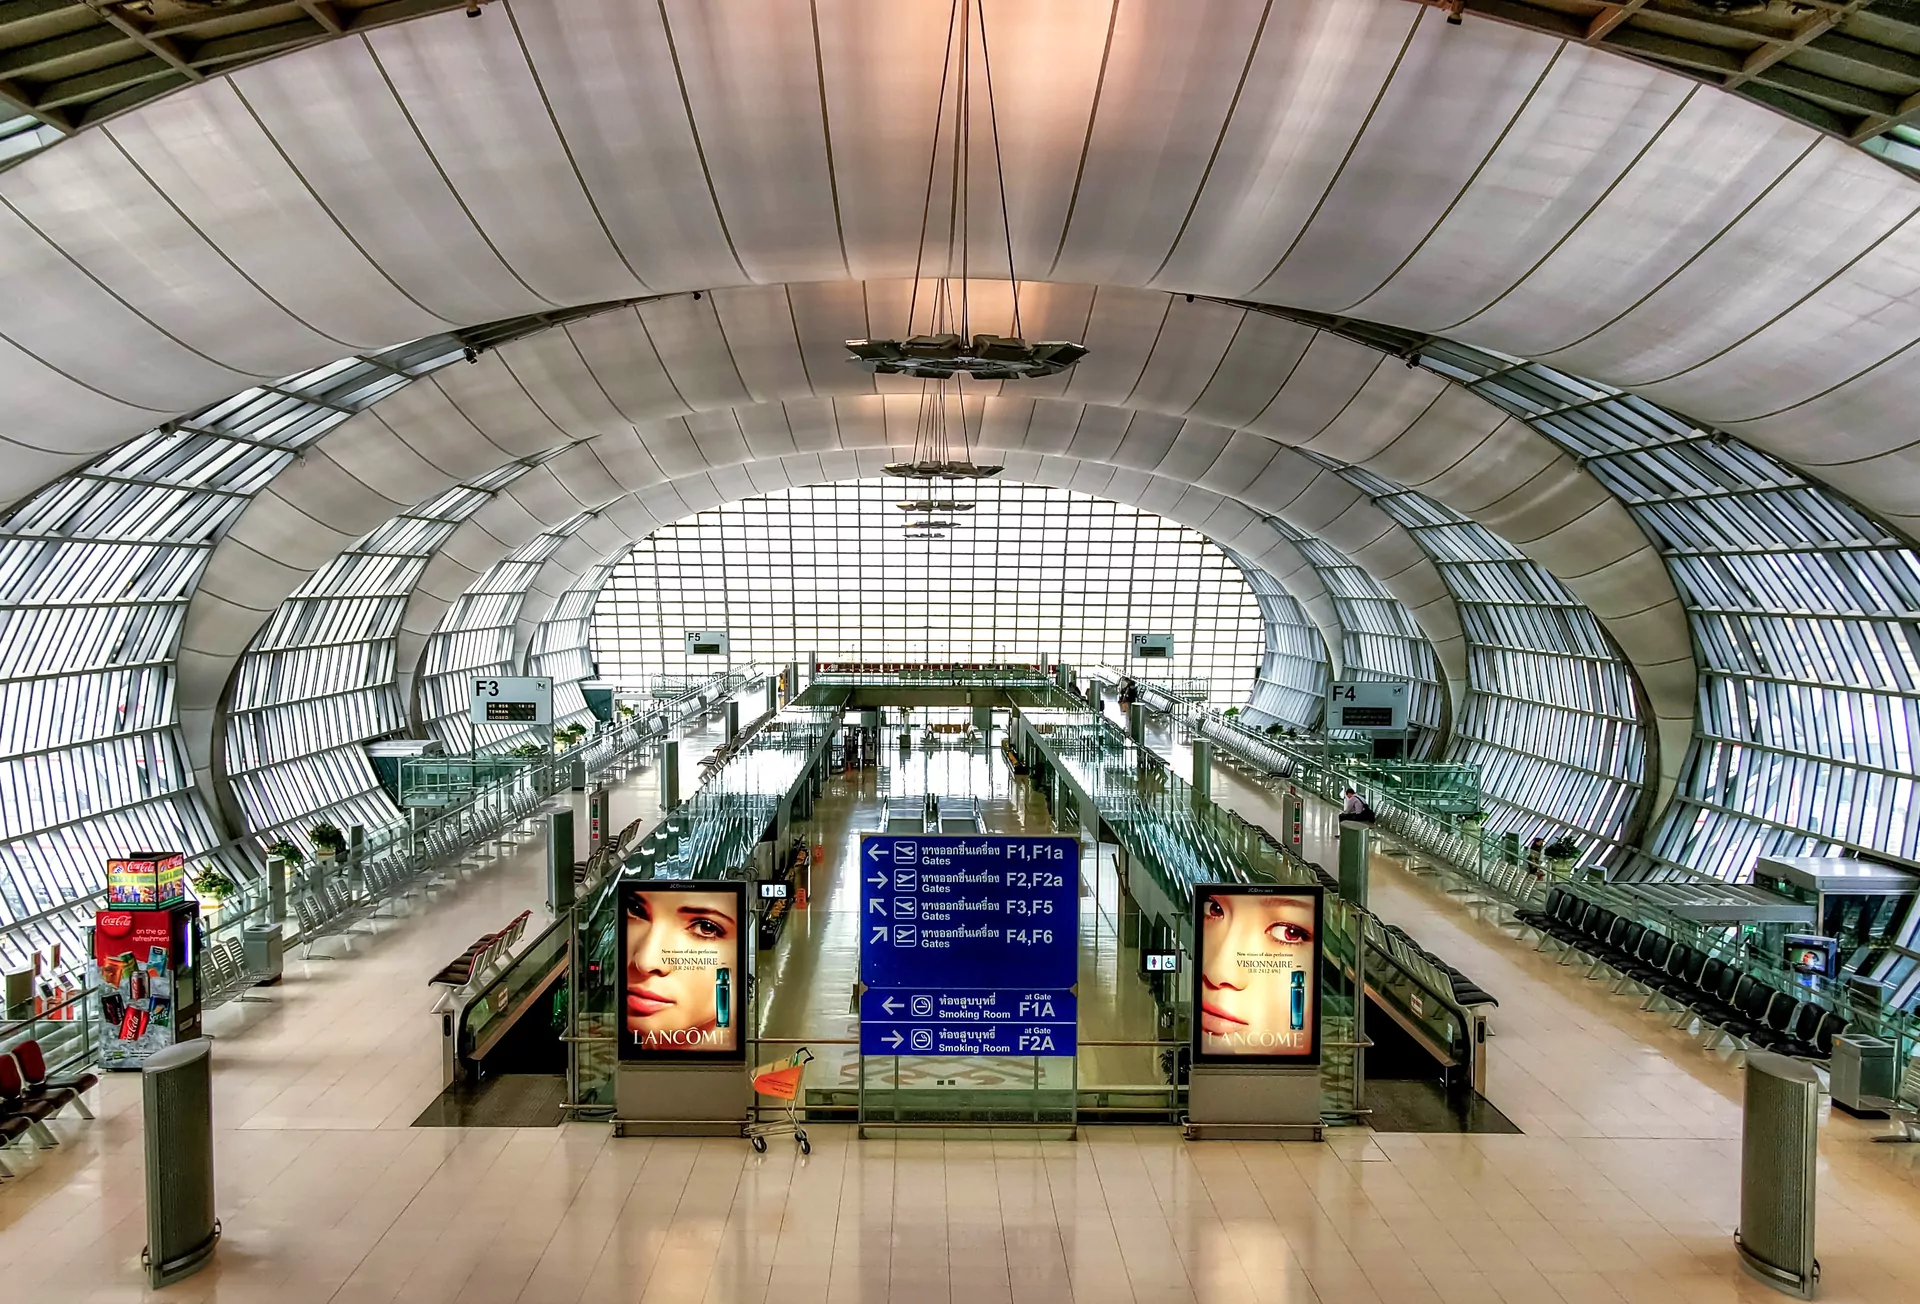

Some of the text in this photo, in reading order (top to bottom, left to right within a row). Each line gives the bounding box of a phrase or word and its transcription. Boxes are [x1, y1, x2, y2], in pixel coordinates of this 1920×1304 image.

[688, 632, 700, 642] F5
[1134, 636, 1148, 644] F6
[476, 680, 499, 696] F3
[1332, 686, 1356, 702] F4
[921, 840, 1000, 855] ทางออกขึ้นเครื่อง
[1006, 845, 1064, 862] F1,F1a
[922, 856, 951, 865] Gates
[921, 868, 1000, 883] ทางออกขึ้นเครื่อง
[1006, 872, 1063, 889] F2,F2a
[922, 884, 951, 893] Gates
[921, 896, 1000, 911] ทางออกขึ้นเครื่อง
[1006, 900, 1053, 917] F3,F5
[922, 912, 951, 921] Gates
[921, 924, 1000, 938] ทางออกขึ้นเครื่อง
[1006, 930, 1053, 946] F4,F6
[922, 939, 951, 948] Gates
[939, 1010, 1010, 1020] Smoking Room
[1019, 1002, 1055, 1017] F1A
[149, 1011, 168, 1024] Sprite
[634, 1027, 730, 1045] LANCÔME
[1019, 1036, 1055, 1050] F2A
[1208, 1030, 1304, 1048] LANCÔME
[939, 1044, 979, 1053] Smoking
